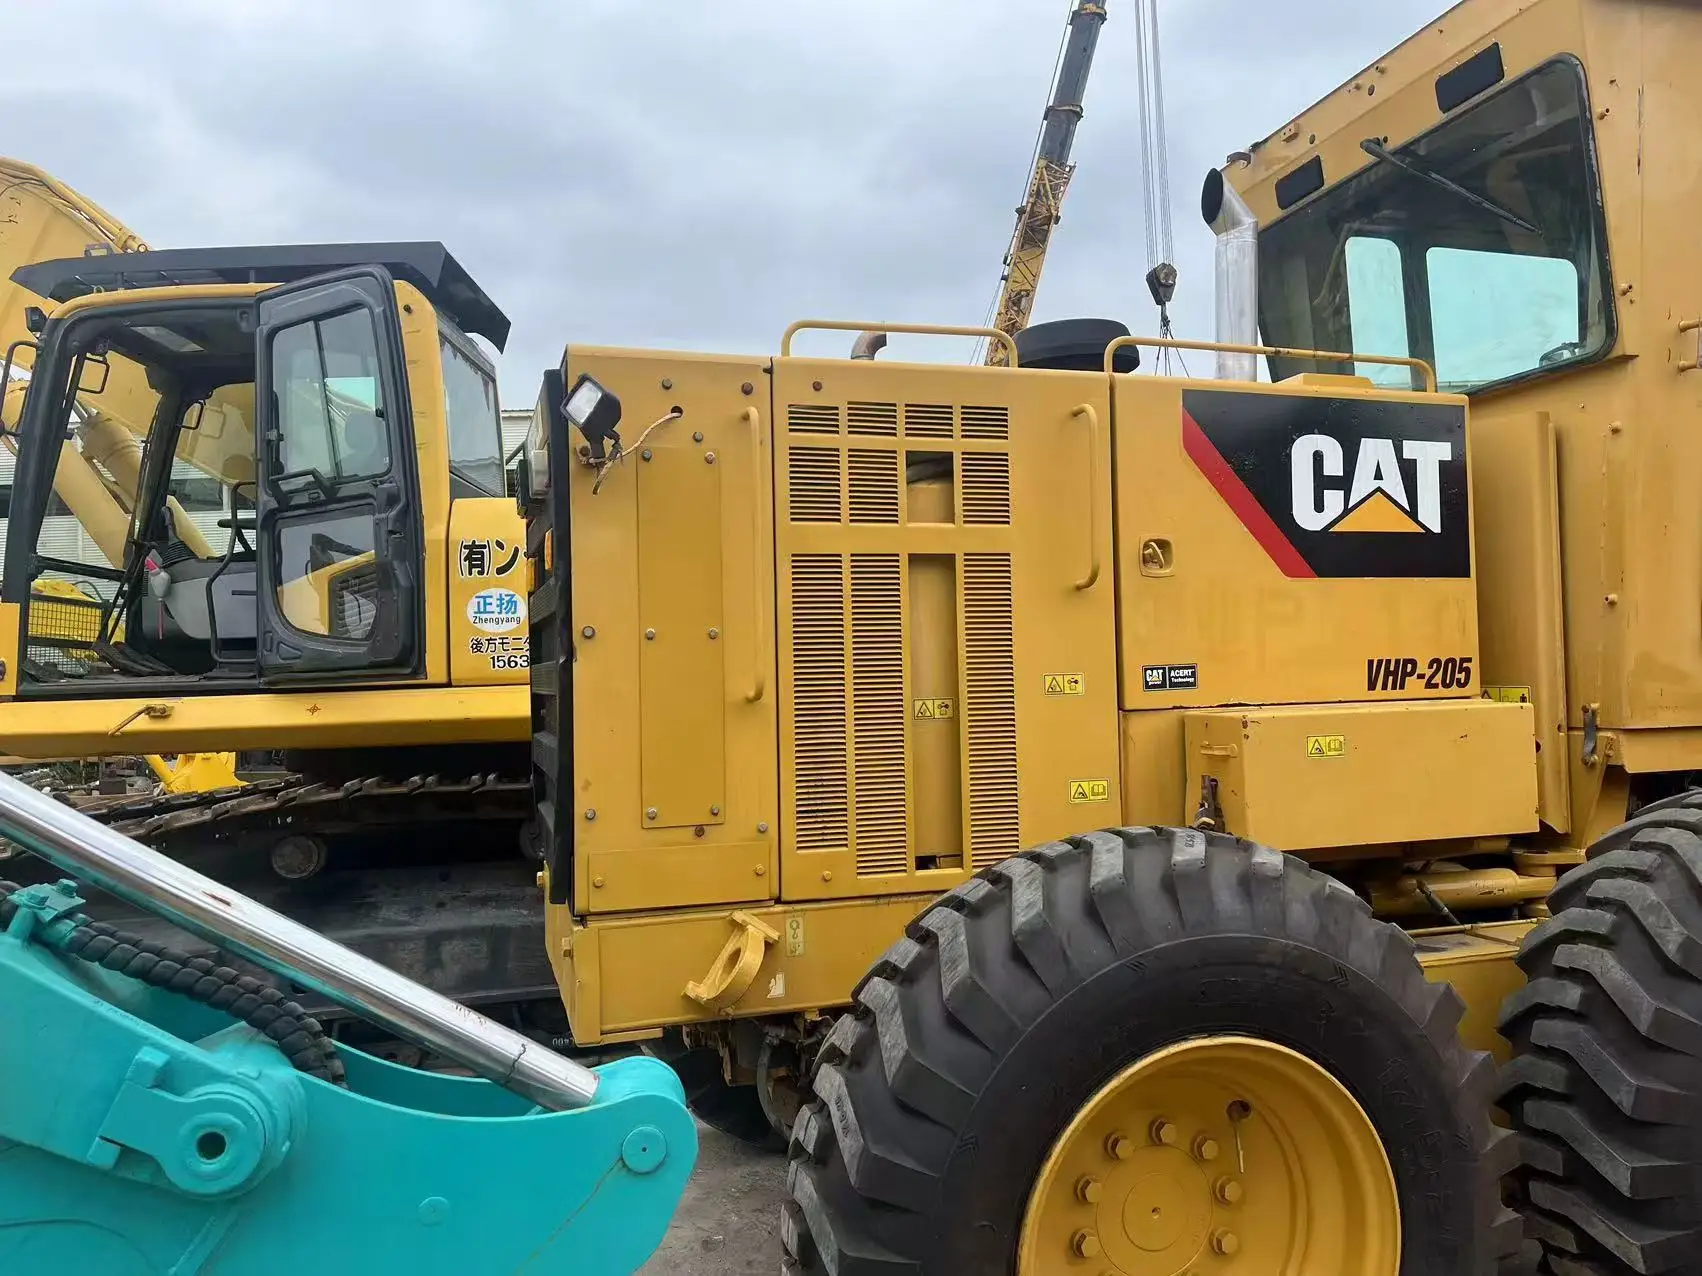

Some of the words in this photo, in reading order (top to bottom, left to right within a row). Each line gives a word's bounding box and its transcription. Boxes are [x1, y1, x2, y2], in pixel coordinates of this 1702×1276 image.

[1291, 434, 1452, 533] CAT
[459, 540, 528, 576] (有)ン
[473, 593, 518, 615] 正扬
[472, 615, 521, 625] Zhengyang
[489, 655, 529, 669] 1563
[1145, 669, 1163, 681] CAT
[1367, 657, 1472, 691] VHP-205
